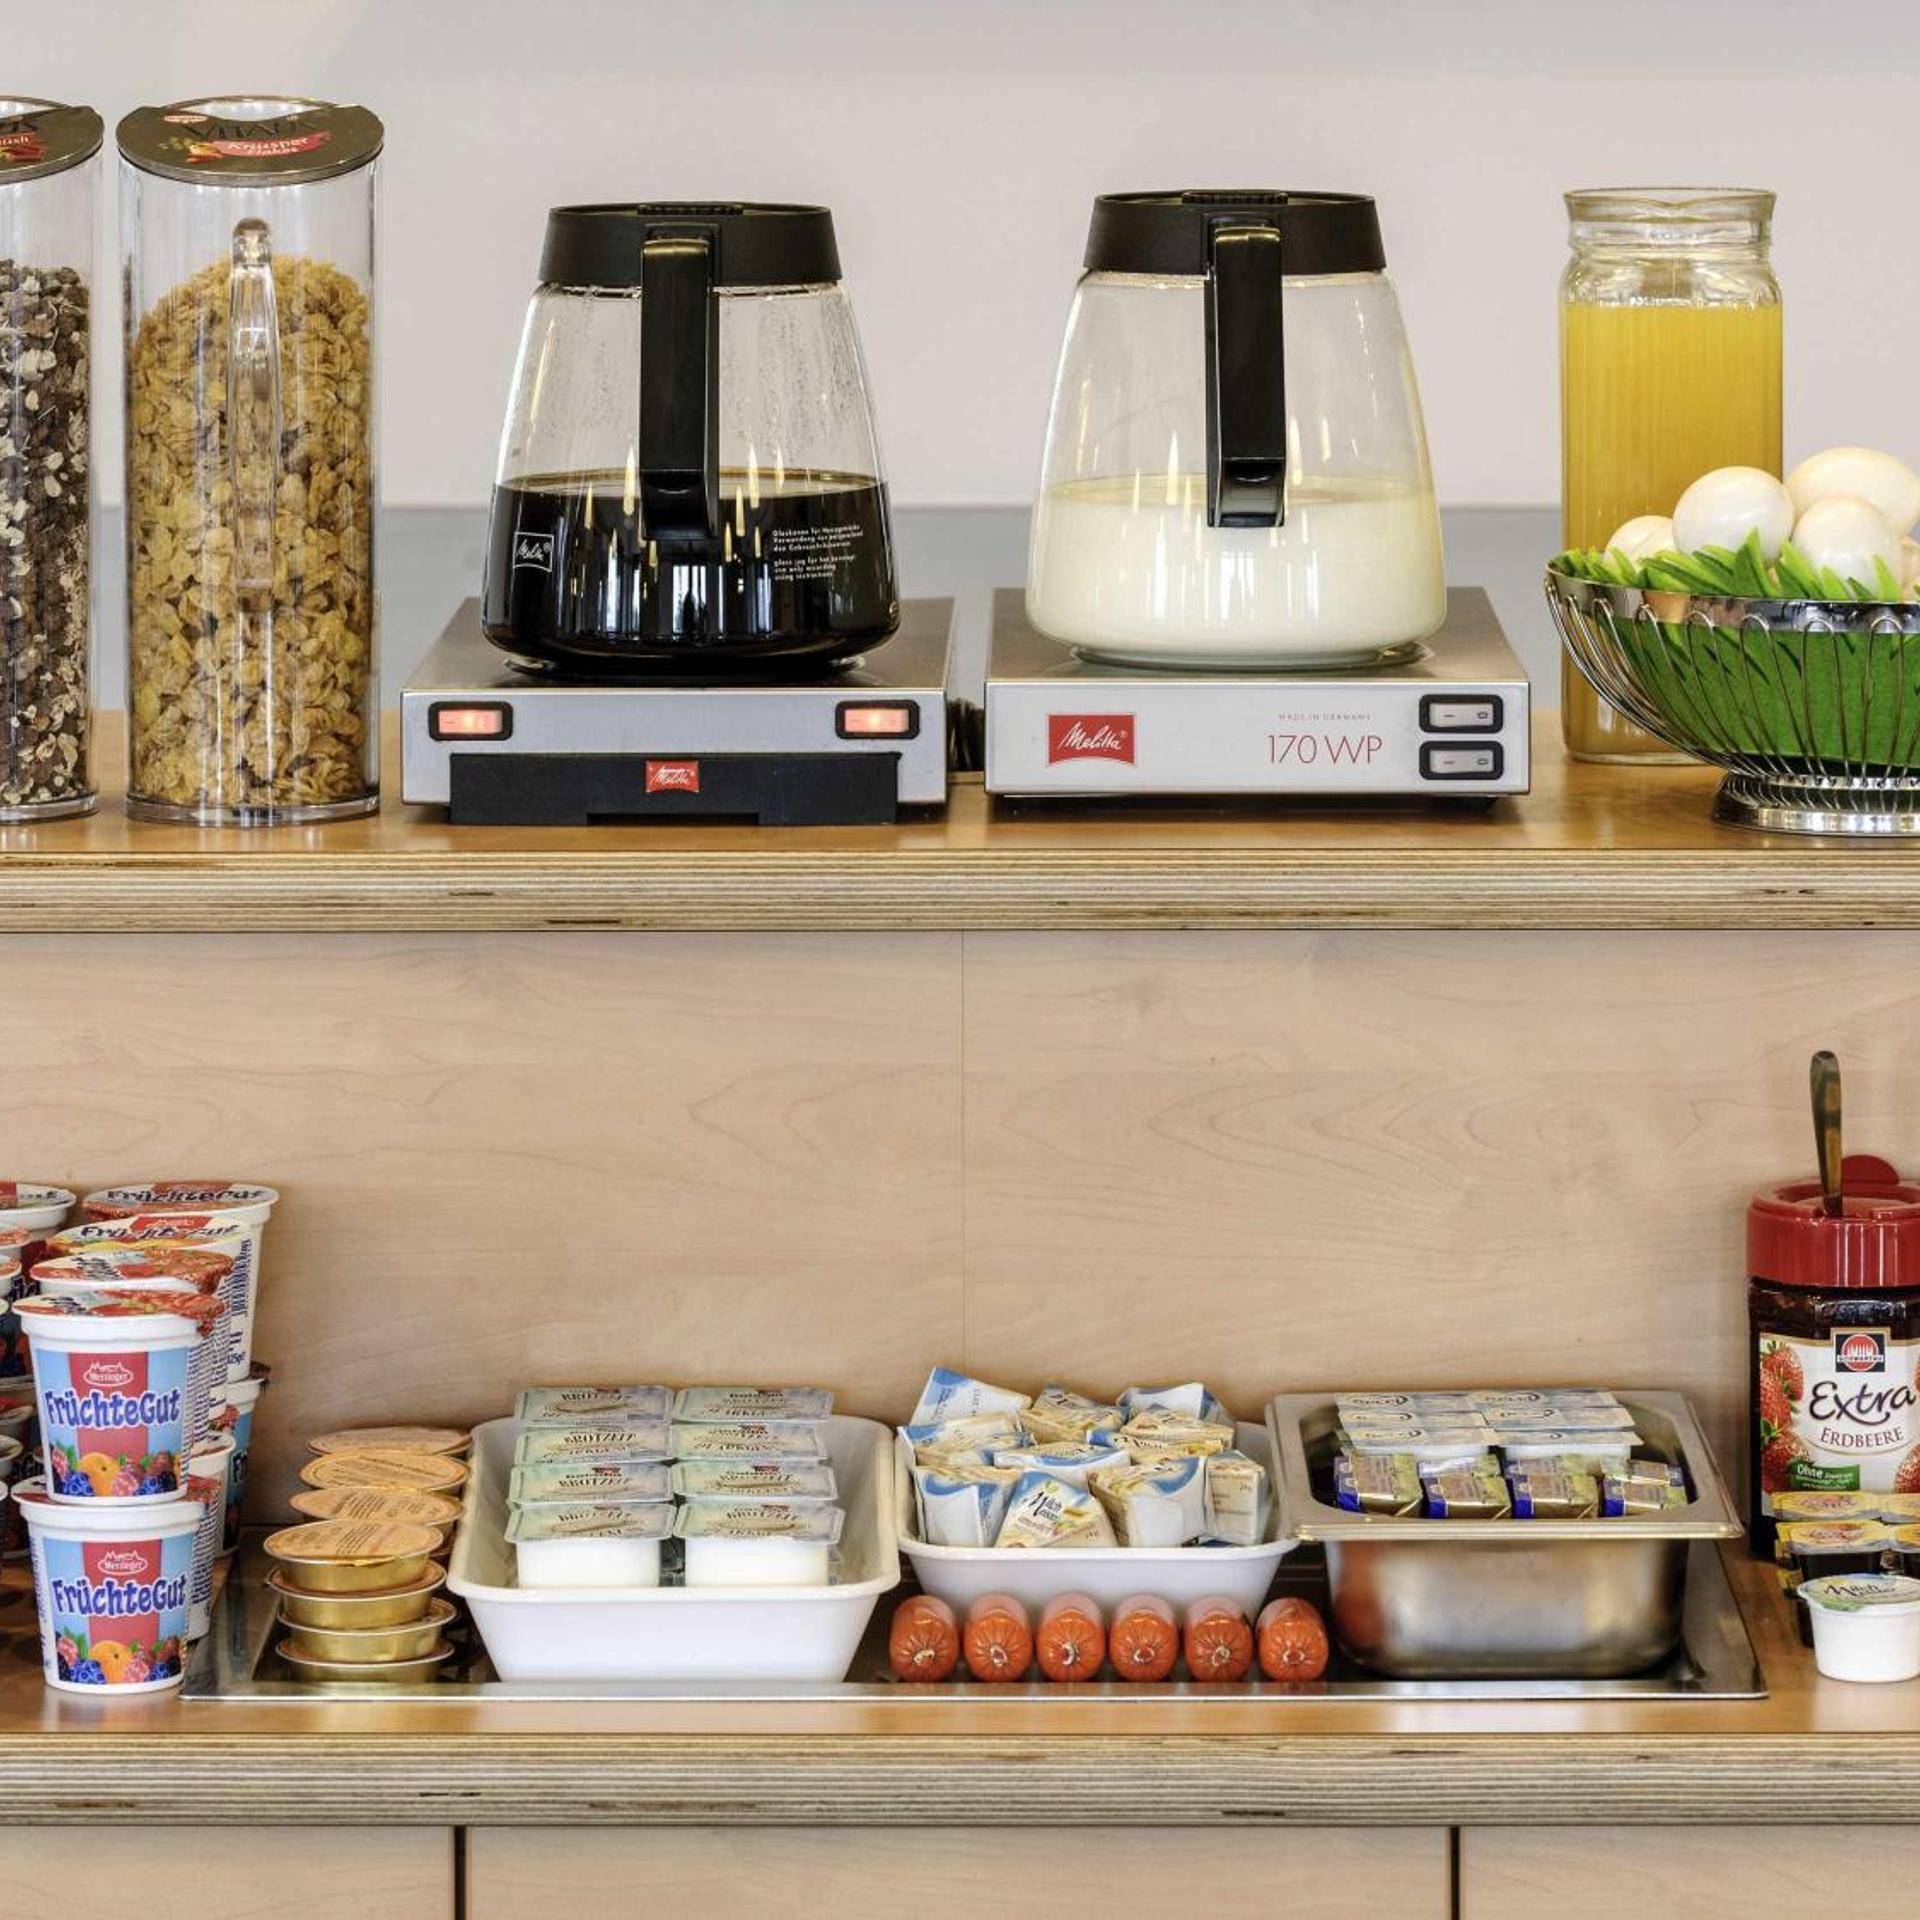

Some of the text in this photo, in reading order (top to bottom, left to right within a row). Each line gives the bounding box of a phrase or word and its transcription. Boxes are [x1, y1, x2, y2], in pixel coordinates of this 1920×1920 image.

[1058, 721, 1122, 751] Melitta
[1267, 735, 1382, 763] 170 WP
[45, 1388, 182, 1428] FrüchteGut
[1809, 1380, 1916, 1426] Extra
[1820, 1426, 1904, 1448] ERDBEERE
[1797, 1463, 1823, 1479] Ohne
[52, 1576, 187, 1617] FrüchteGut
